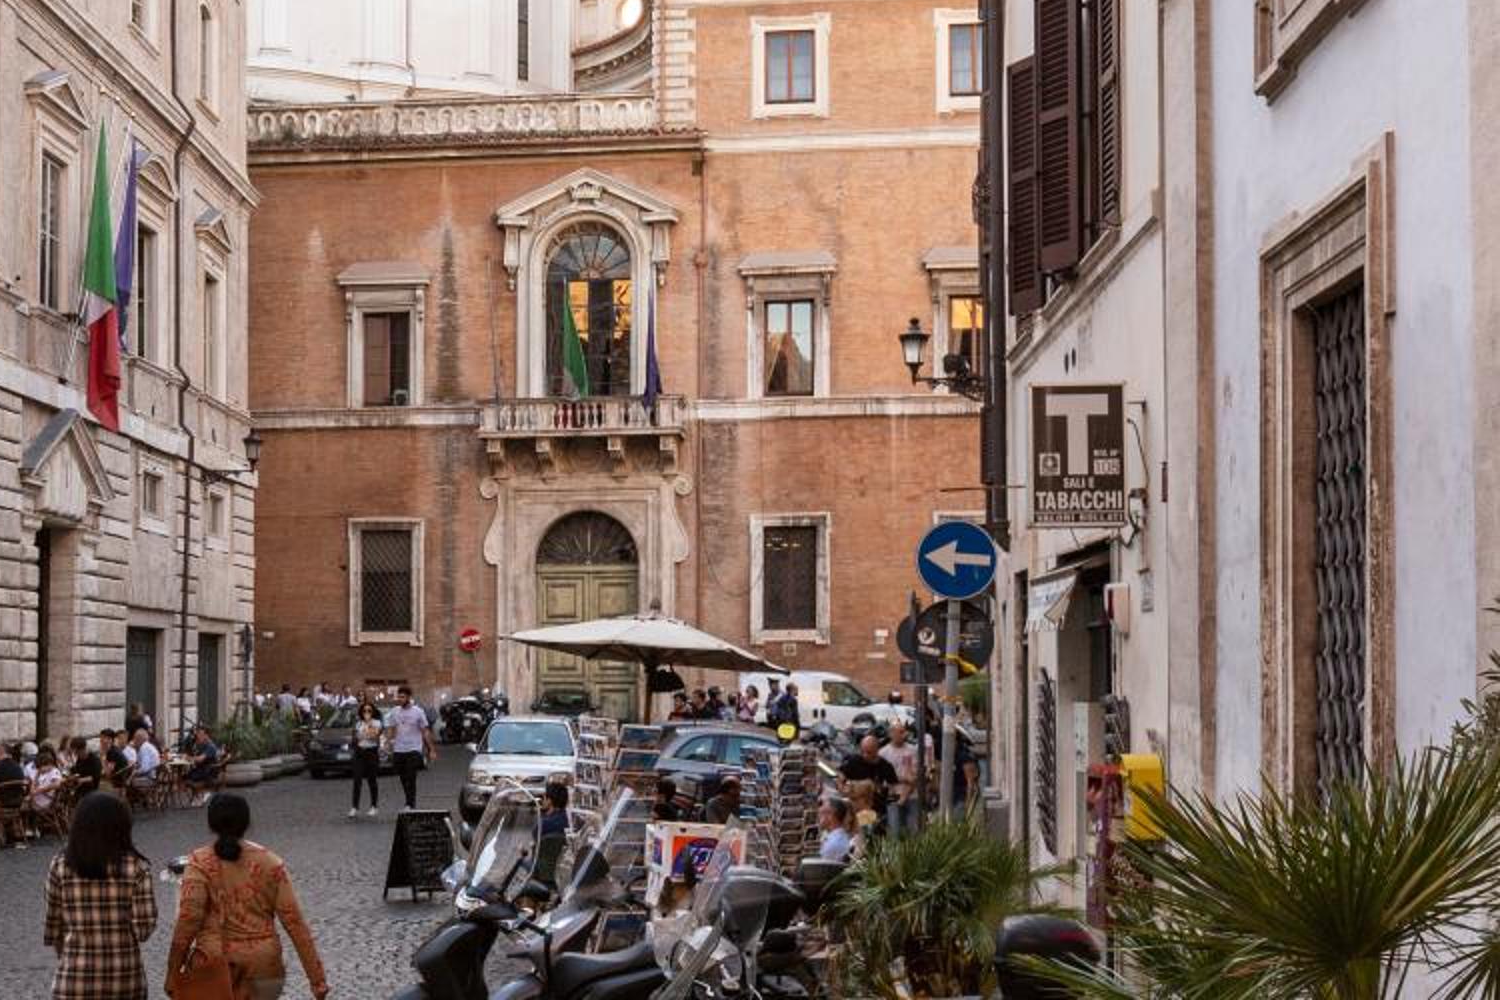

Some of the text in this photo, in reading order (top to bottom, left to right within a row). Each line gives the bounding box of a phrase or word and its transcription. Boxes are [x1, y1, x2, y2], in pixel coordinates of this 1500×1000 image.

[1045, 393, 1109, 475] T
[1063, 477, 1086, 489] SALI
[1035, 491, 1123, 510] TABACCHI
